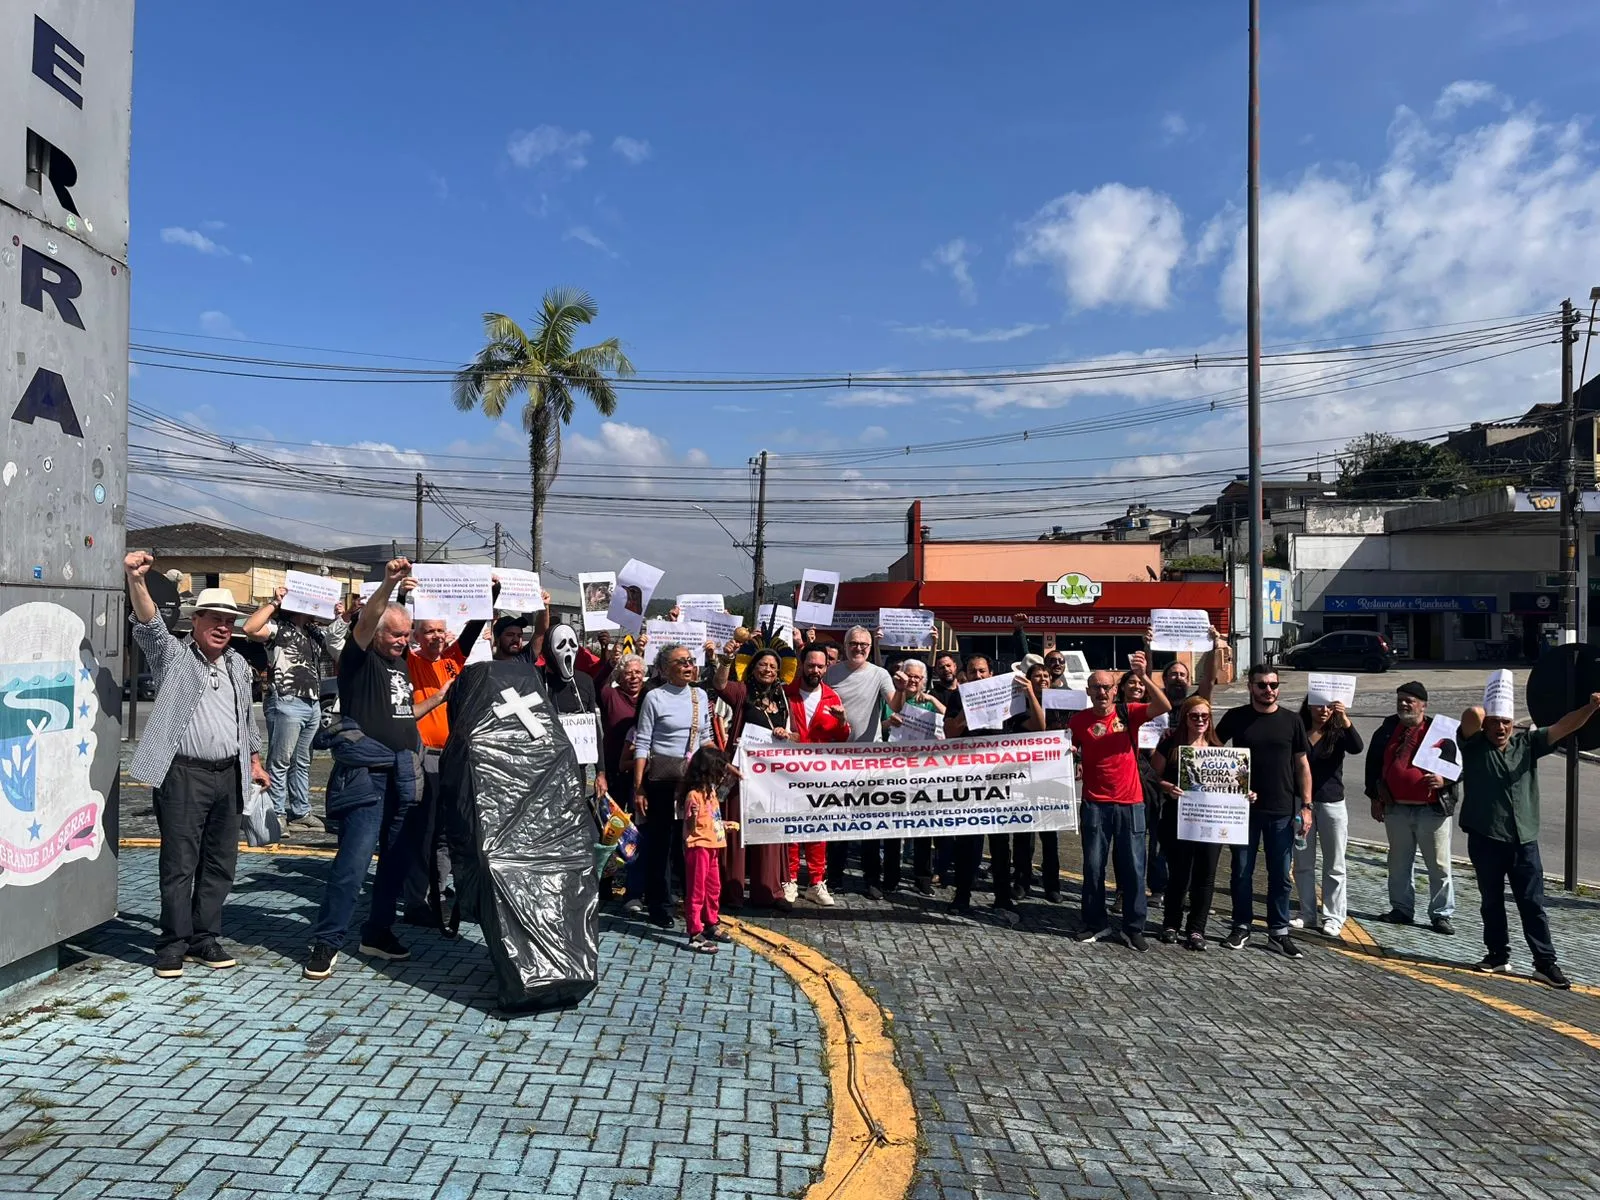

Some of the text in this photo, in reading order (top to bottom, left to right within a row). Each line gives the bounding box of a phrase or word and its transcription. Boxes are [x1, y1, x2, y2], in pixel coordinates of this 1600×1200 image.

[1049, 584, 1100, 594] TREVO
[1358, 598, 1406, 610] Restaurante
[973, 615, 1012, 623] PADARIA
[1028, 616, 1094, 624] RESTAURANTE
[1109, 616, 1151, 624] PIZZARIA
[747, 749, 812, 757] PREFEITO
[952, 741, 998, 750] SEJAM
[1195, 749, 1239, 759] MANANCIAL
[752, 762, 766, 773] O
[770, 761, 826, 773] POVO
[831, 757, 920, 771] MERECE
[924, 756, 939, 768] A
[788, 779, 865, 789] POPULAÇÃO
[910, 776, 964, 784] GRANDE
[985, 772, 1026, 781] SERRA
[806, 786, 1010, 808] VAMOS A LUTA!
[1004, 804, 1069, 812] MANANCIAIS
[784, 823, 829, 834] DIGA
[833, 820, 872, 832] NÃO
[876, 820, 888, 830] A
[42, 842, 54, 862] DA
[57, 810, 91, 851] SERRA
